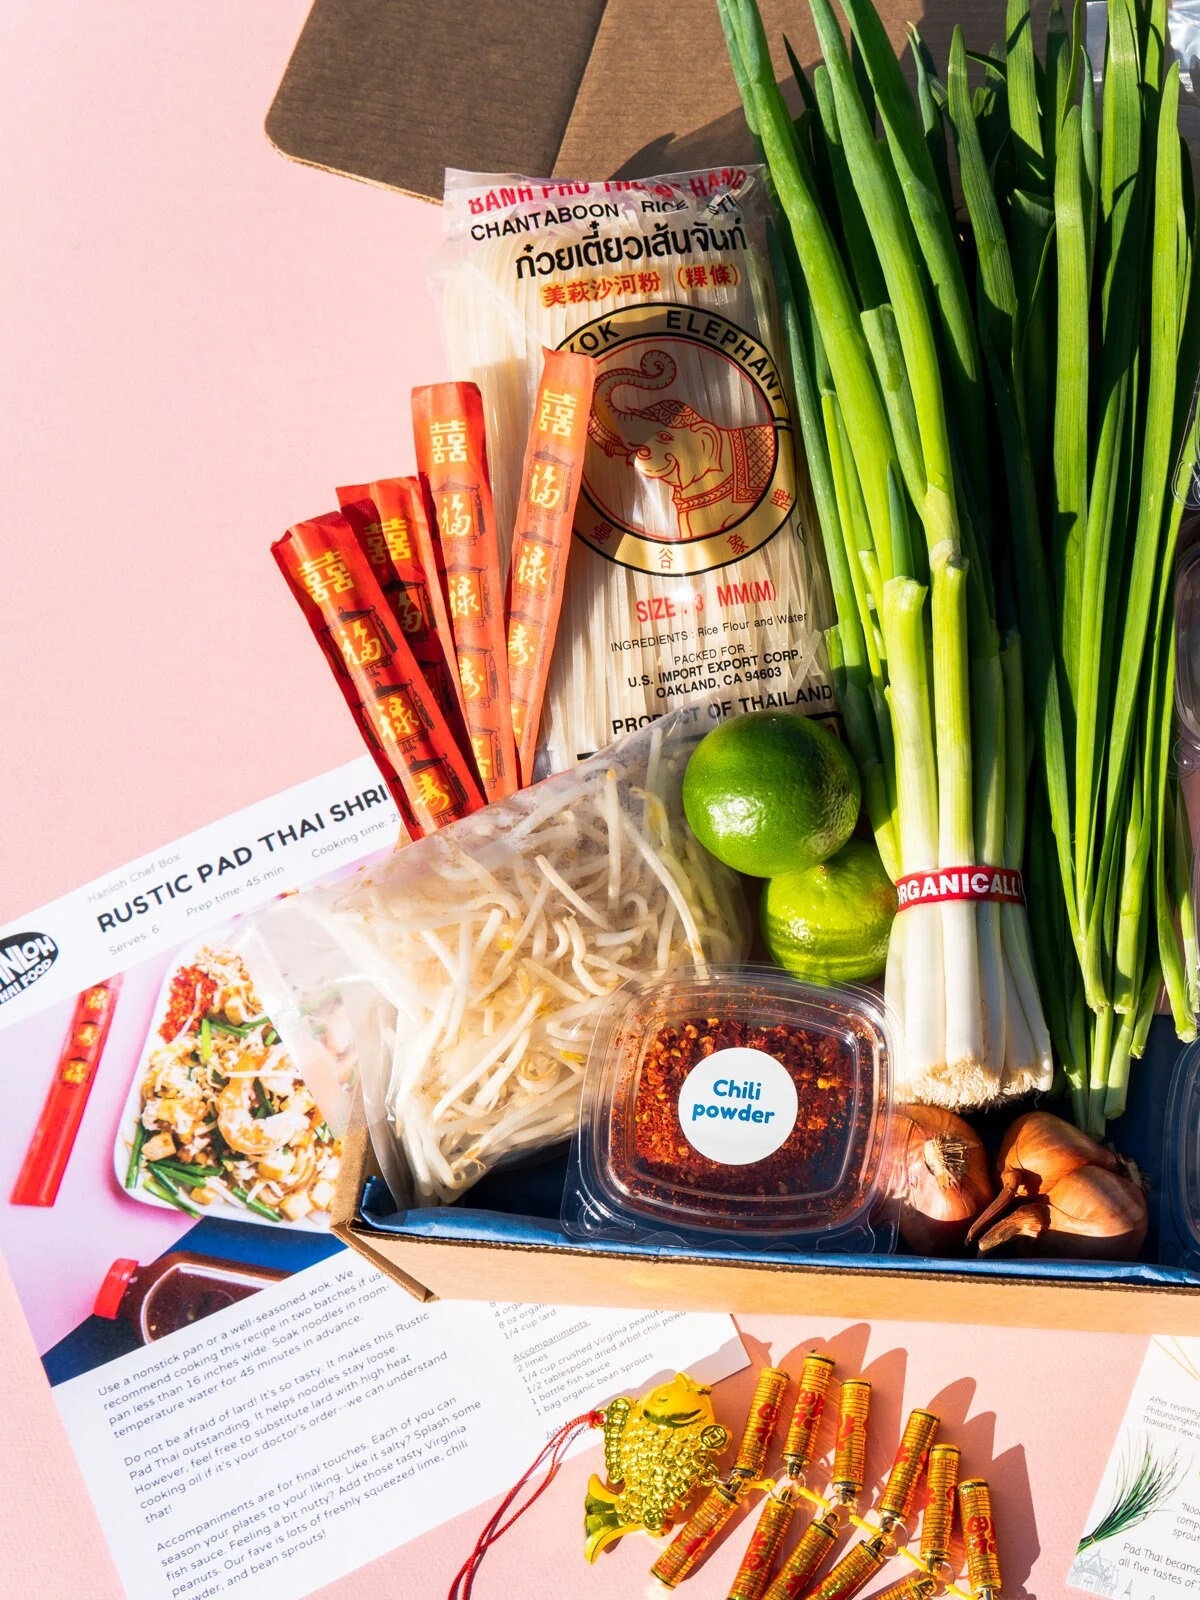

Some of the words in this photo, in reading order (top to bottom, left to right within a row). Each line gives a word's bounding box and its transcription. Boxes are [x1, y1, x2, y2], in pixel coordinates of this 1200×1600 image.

[471, 203, 620, 241] CHANTABOON
[667, 310, 784, 403] ELEPHANT
[717, 579, 777, 607] MM(M)
[611, 631, 689, 652] INGREDIENTS
[698, 626, 719, 637] Rice
[723, 621, 750, 632] Flour
[754, 616, 773, 628] and
[777, 612, 808, 625] Water
[628, 675, 654, 688] U.S.
[658, 665, 703, 684] IMPORT
[708, 656, 759, 675] EXPORT
[764, 649, 803, 664] CORP.
[674, 648, 717, 665] PACKED
[721, 644, 745, 656] FOR
[656, 678, 720, 698] OAKLAND,
[723, 674, 743, 686] CA
[745, 666, 782, 682] 94603
[707, 700, 732, 718] OF
[738, 684, 833, 713] THAILAND
[311, 833, 358, 857] Cooking
[359, 820, 387, 836] time:
[96, 874, 192, 932] RUSTIC
[196, 846, 252, 883] PAD
[257, 812, 325, 853] THAI
[329, 784, 391, 822] SHRI
[185, 899, 212, 917] Prep
[214, 885, 241, 903] time:
[245, 875, 261, 887] 45
[263, 866, 284, 880] min
[898, 873, 1019, 905] RGANICALL
[108, 931, 149, 955] Serves:
[151, 924, 159, 934] 6
[20, 958, 52, 989] FOOD
[713, 1079, 762, 1100] Chili
[692, 1103, 775, 1124] powder
[97, 1382, 120, 1396] Use
[123, 1377, 130, 1385] a
[132, 1353, 180, 1380] nonstick
[182, 1343, 204, 1360] pan
[206, 1335, 217, 1346] or
[229, 1291, 306, 1334] well-seasoned
[308, 1280, 333, 1296] wok.
[334, 1270, 353, 1282] We
[103, 1372, 171, 1410] recommend
[173, 1352, 218, 1377] cooking
[219, 1341, 240, 1355] this
[242, 1324, 276, 1344] recipe
[277, 1318, 289, 1327] in
[291, 1307, 311, 1320] two
[313, 1284, 356, 1309] batches
[358, 1277, 365, 1287] if
[108, 1409, 130, 1426] pan
[132, 1398, 155, 1413] less
[156, 1385, 183, 1401] than
[186, 1375, 200, 1388] 16
[203, 1358, 239, 1380] inches
[240, 1345, 267, 1361] wide.
[271, 1328, 299, 1346] Soak
[301, 1306, 343, 1332] noodles
[344, 1301, 355, 1310] in
[113, 1401, 184, 1438] temperature
[186, 1384, 217, 1403] water
[220, 1375, 236, 1387] for
[240, 1365, 254, 1377] 45
[257, 1344, 300, 1370] minutes
[302, 1338, 313, 1347] in
[315, 1314, 363, 1341] advance.
[524, 1353, 548, 1368] limes
[538, 1384, 565, 1401] bottle
[566, 1375, 583, 1387] fish
[584, 1361, 609, 1377] sauce
[542, 1399, 561, 1412] bag
[562, 1382, 595, 1402] organic
[596, 1370, 619, 1384] bean
[619, 1352, 653, 1373] sprouts
